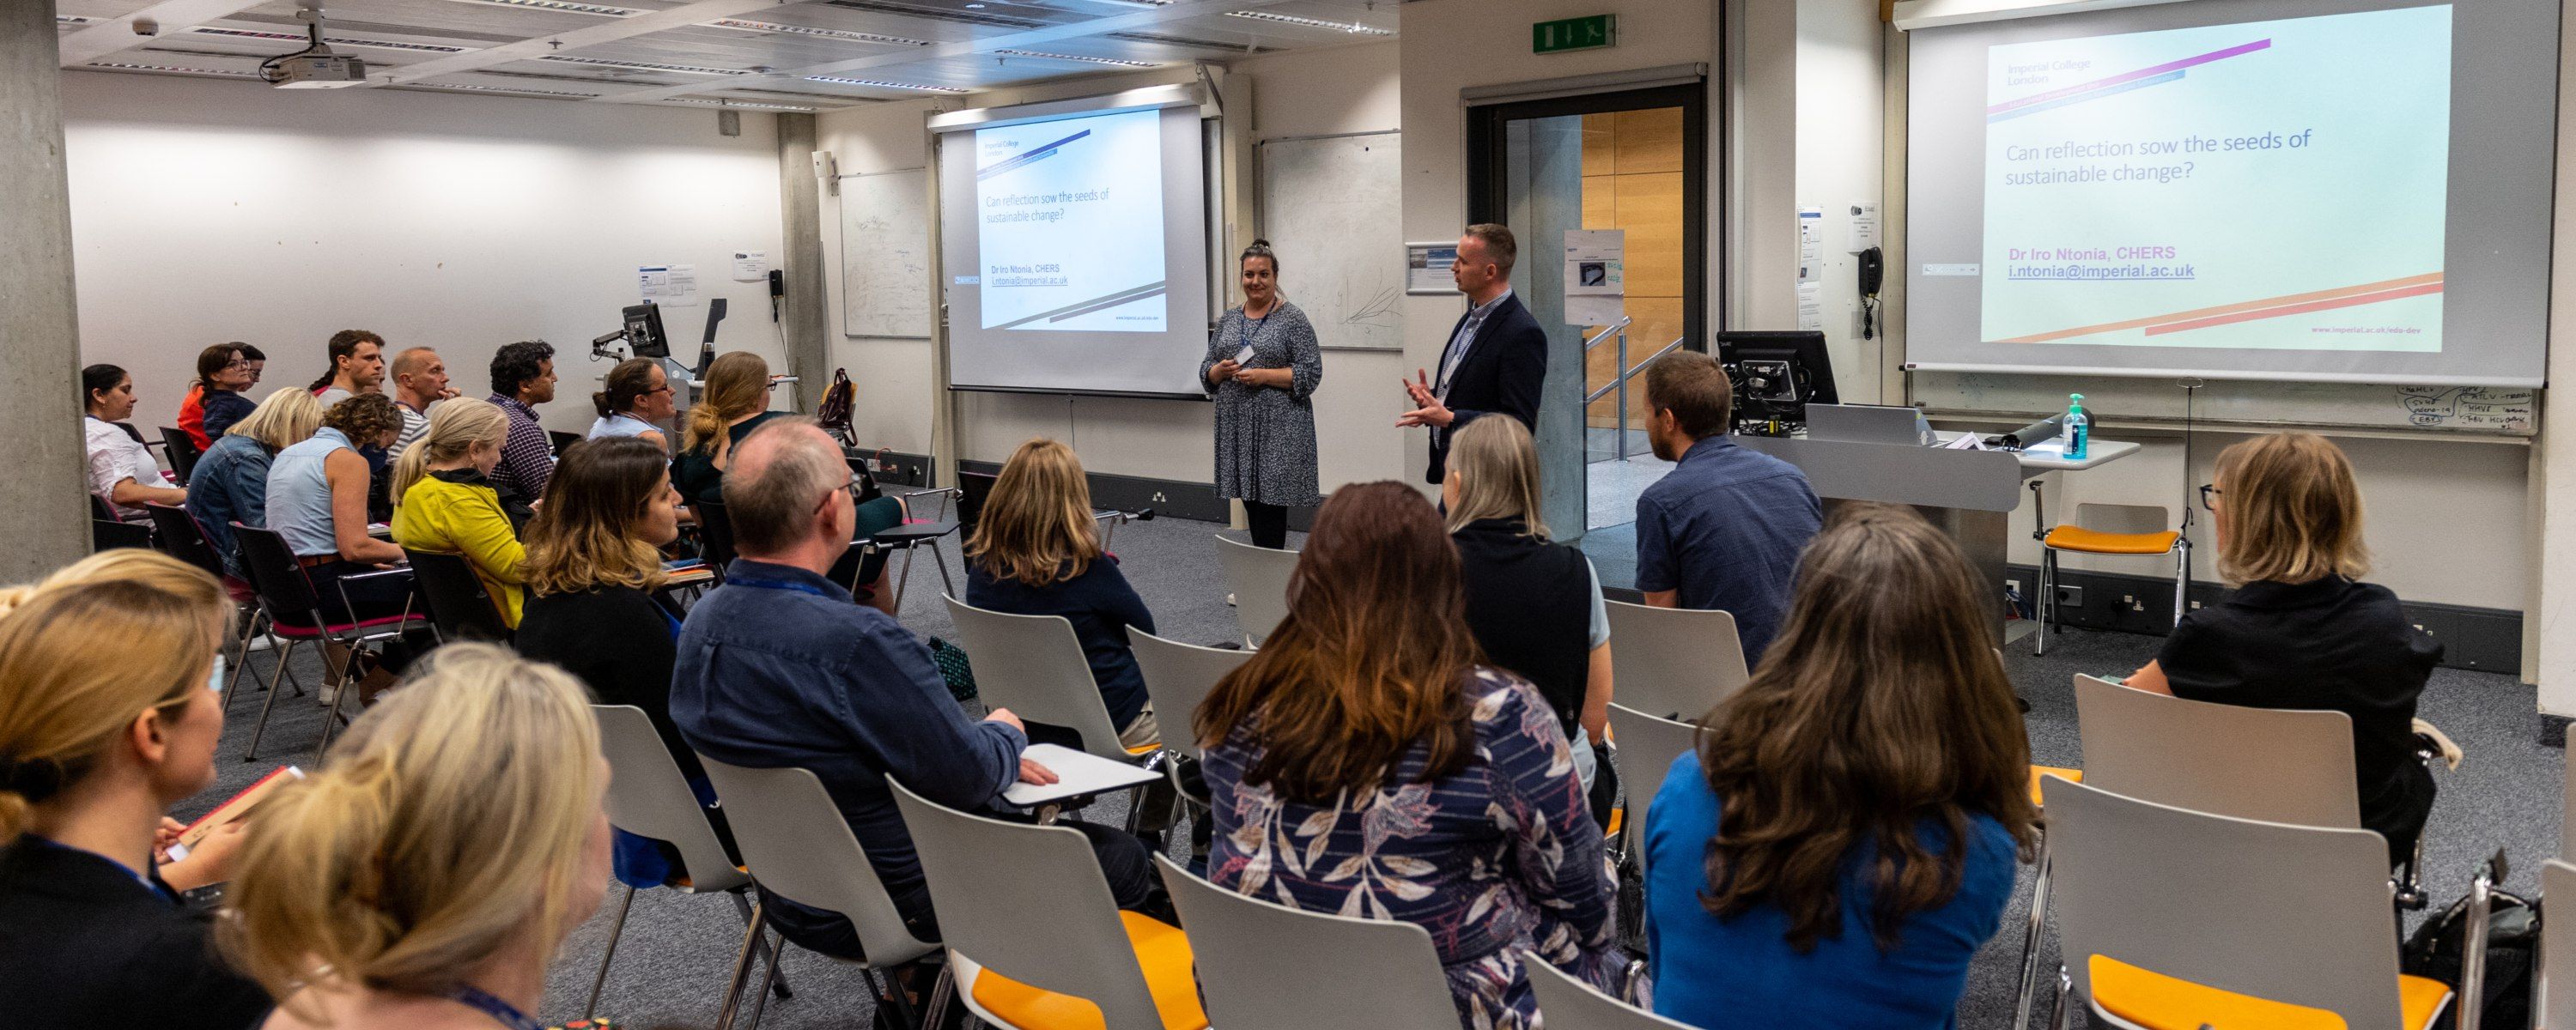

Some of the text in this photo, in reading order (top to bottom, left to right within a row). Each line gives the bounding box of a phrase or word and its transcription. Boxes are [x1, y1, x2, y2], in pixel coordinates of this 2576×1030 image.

[2008, 59, 2091, 75] Imperial College
[2008, 75, 2049, 86] London
[1003, 140, 1019, 148] College
[2007, 129, 2312, 161] Can reflection sow the seeds of
[2005, 161, 2195, 185] sustainable change?
[986, 187, 1109, 207] Can reflection sow the seeds of
[987, 208, 1065, 223] sustainable change?
[2008, 245, 2176, 262] Dr Iro Ntonia, CHERS
[991, 264, 1060, 275] Dr Iro Ntonia, CHERS
[2008, 264, 2195, 280] i.ntonia@imperial.ac.uk
[992, 276, 1068, 287] i.ntonia@imperial.ac.uk
